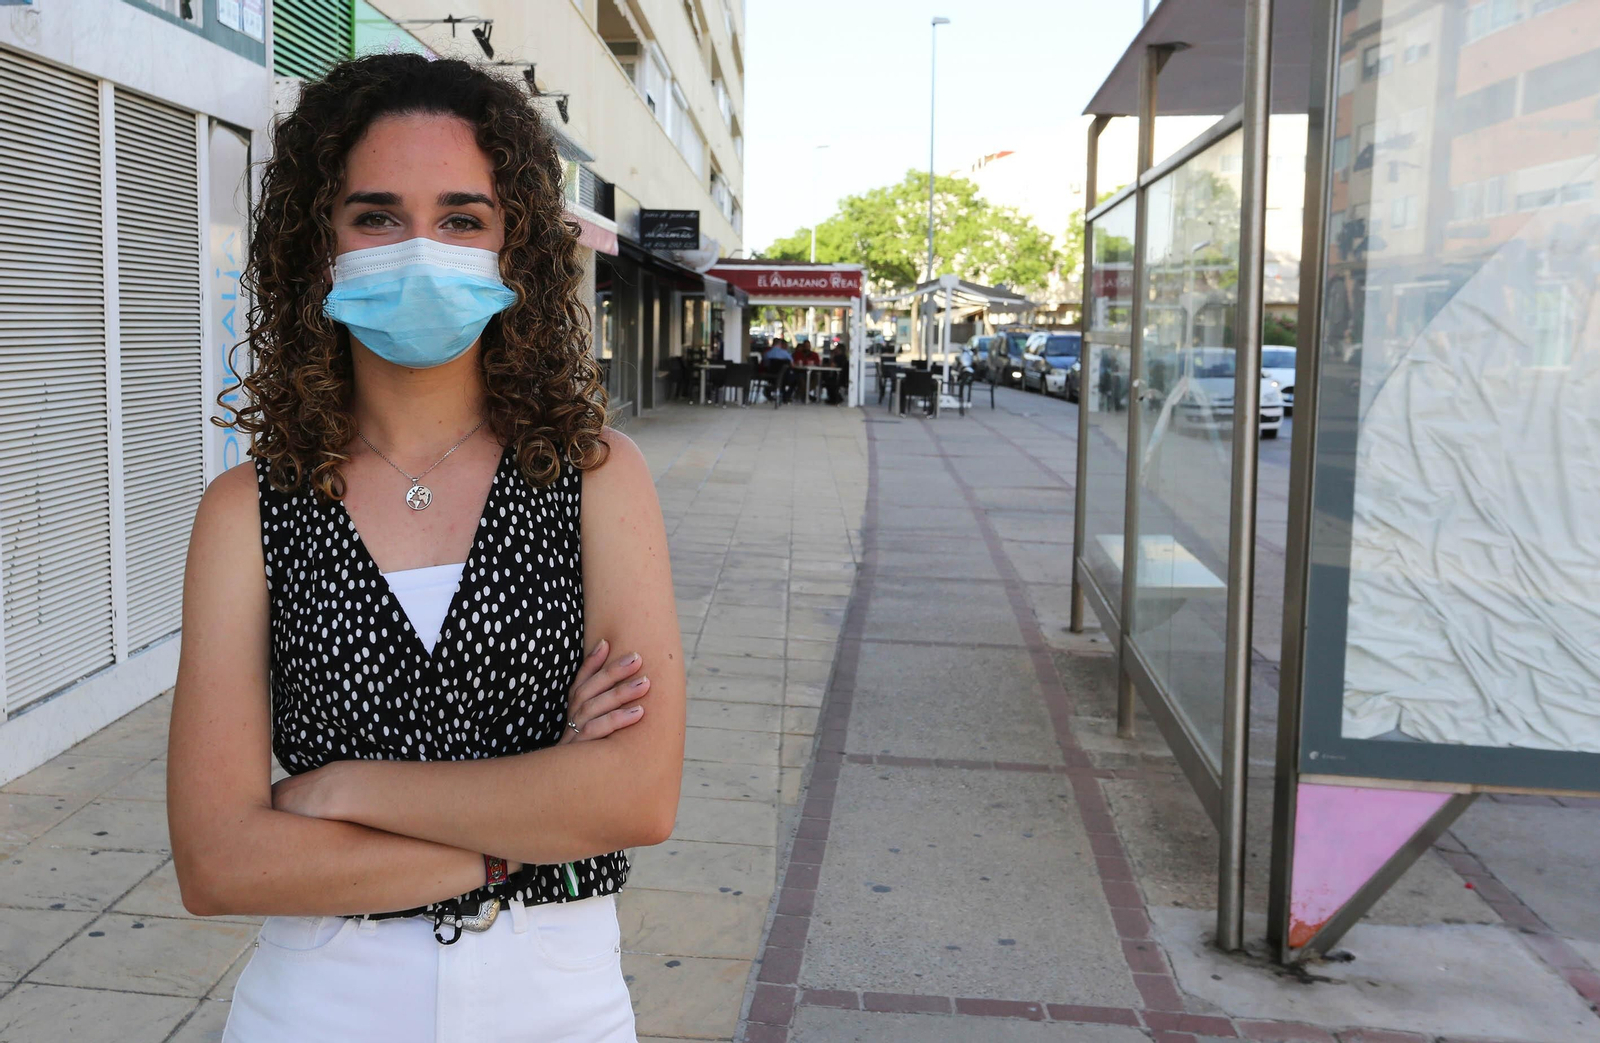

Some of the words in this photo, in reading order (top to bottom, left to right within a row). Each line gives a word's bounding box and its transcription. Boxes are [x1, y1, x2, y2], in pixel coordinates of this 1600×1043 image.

[757, 275, 769, 287] EL
[770, 275, 828, 288] ALBAZANO
[831, 275, 859, 289] REAL
